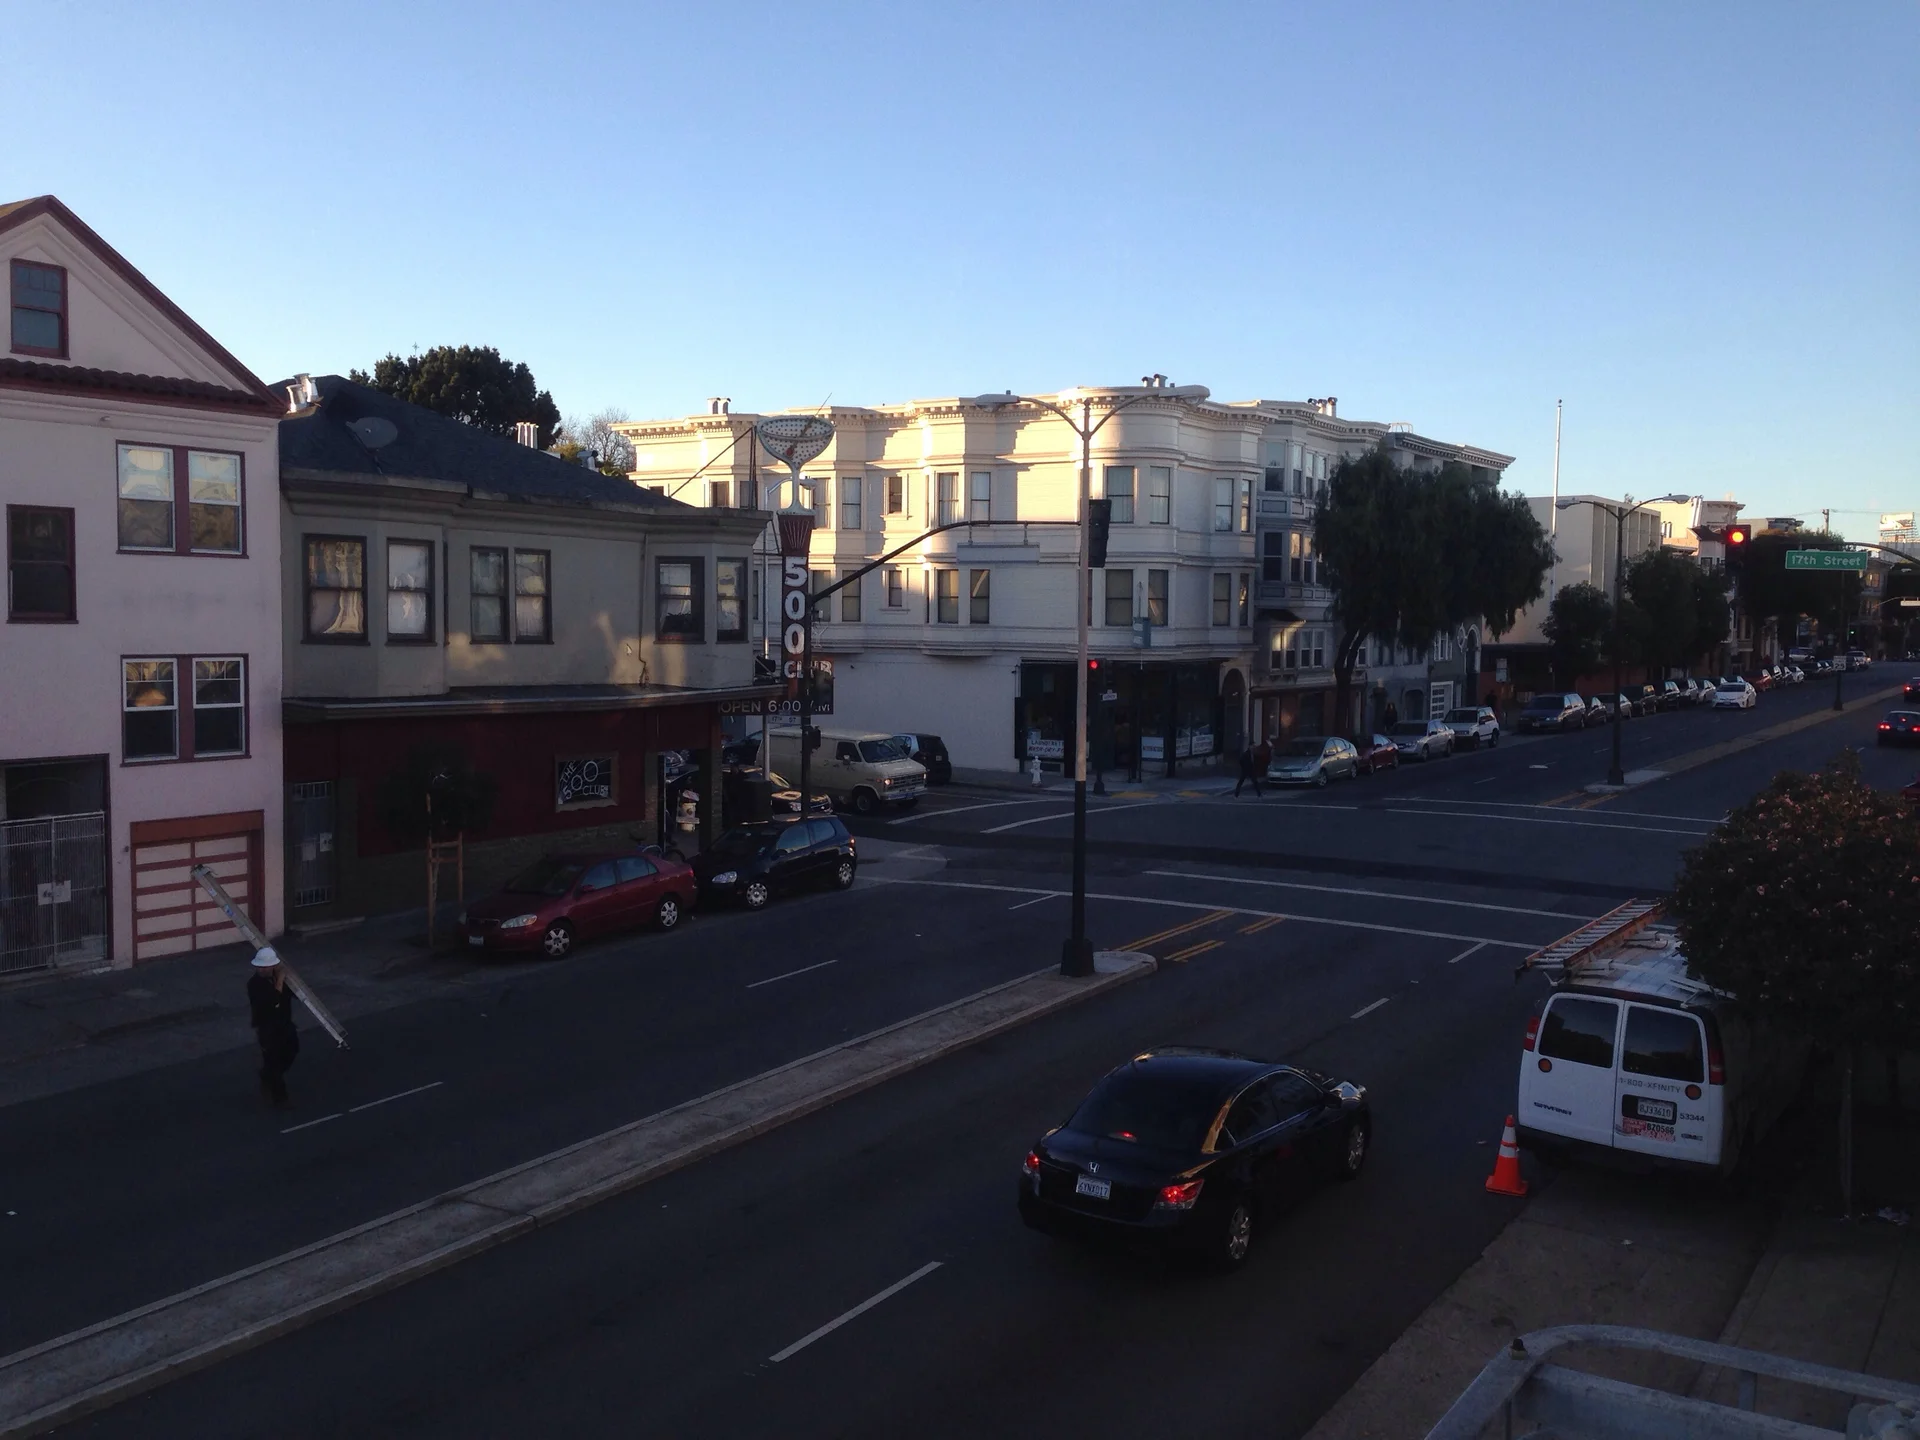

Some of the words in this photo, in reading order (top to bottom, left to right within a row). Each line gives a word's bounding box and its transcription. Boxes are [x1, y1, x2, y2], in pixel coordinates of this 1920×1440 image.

[1791, 555, 1817, 565] 17th
[1823, 555, 1861, 566] Street
[784, 555, 807, 655] 500
[720, 700, 762, 713] OPEN
[768, 700, 802, 712] 6:00
[560, 761, 577, 783] THE
[562, 760, 599, 800] 500
[1619, 1077, 1681, 1093] 1-800-XFINITY
[1679, 1112, 1705, 1122] 53344
